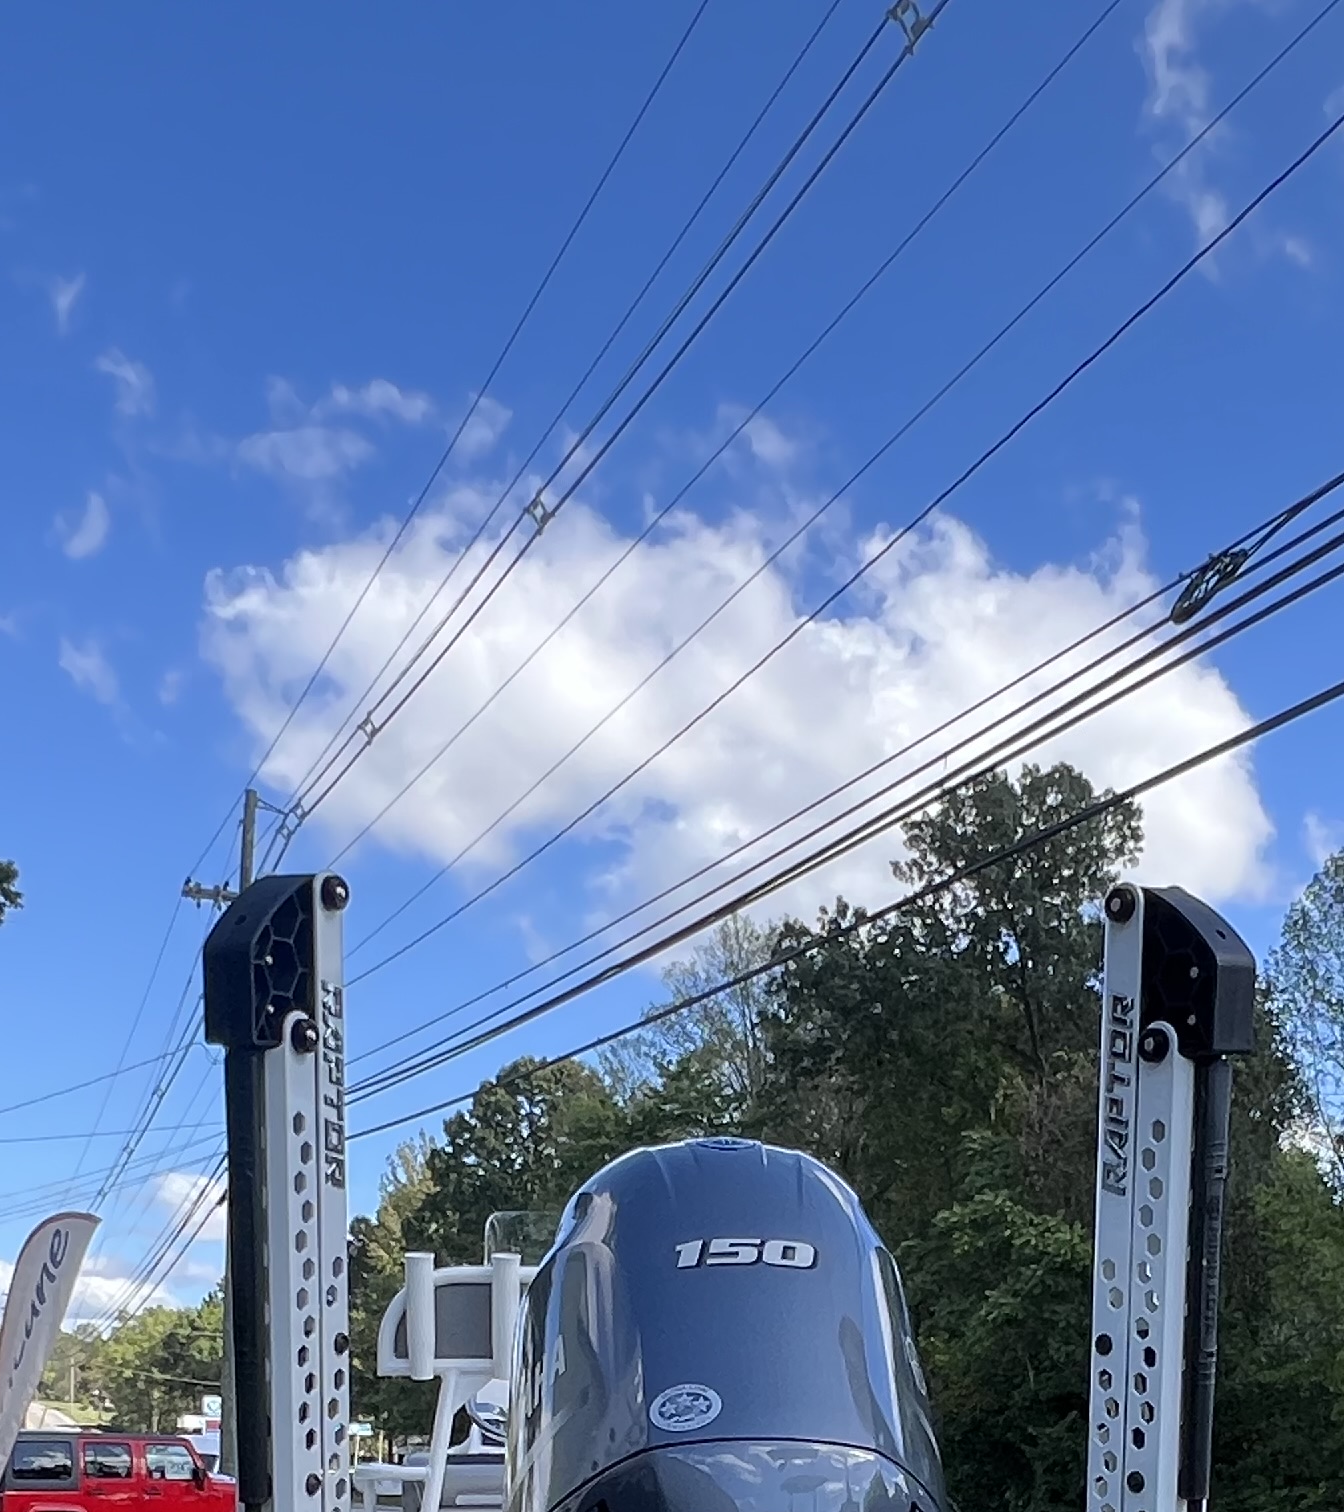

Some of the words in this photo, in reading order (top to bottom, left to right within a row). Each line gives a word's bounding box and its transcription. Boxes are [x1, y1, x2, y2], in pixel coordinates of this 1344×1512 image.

[320, 979, 345, 1191] RAPTOR
[1101, 994, 1135, 1197] RAPTOR
[674, 1238, 817, 1268] 150
